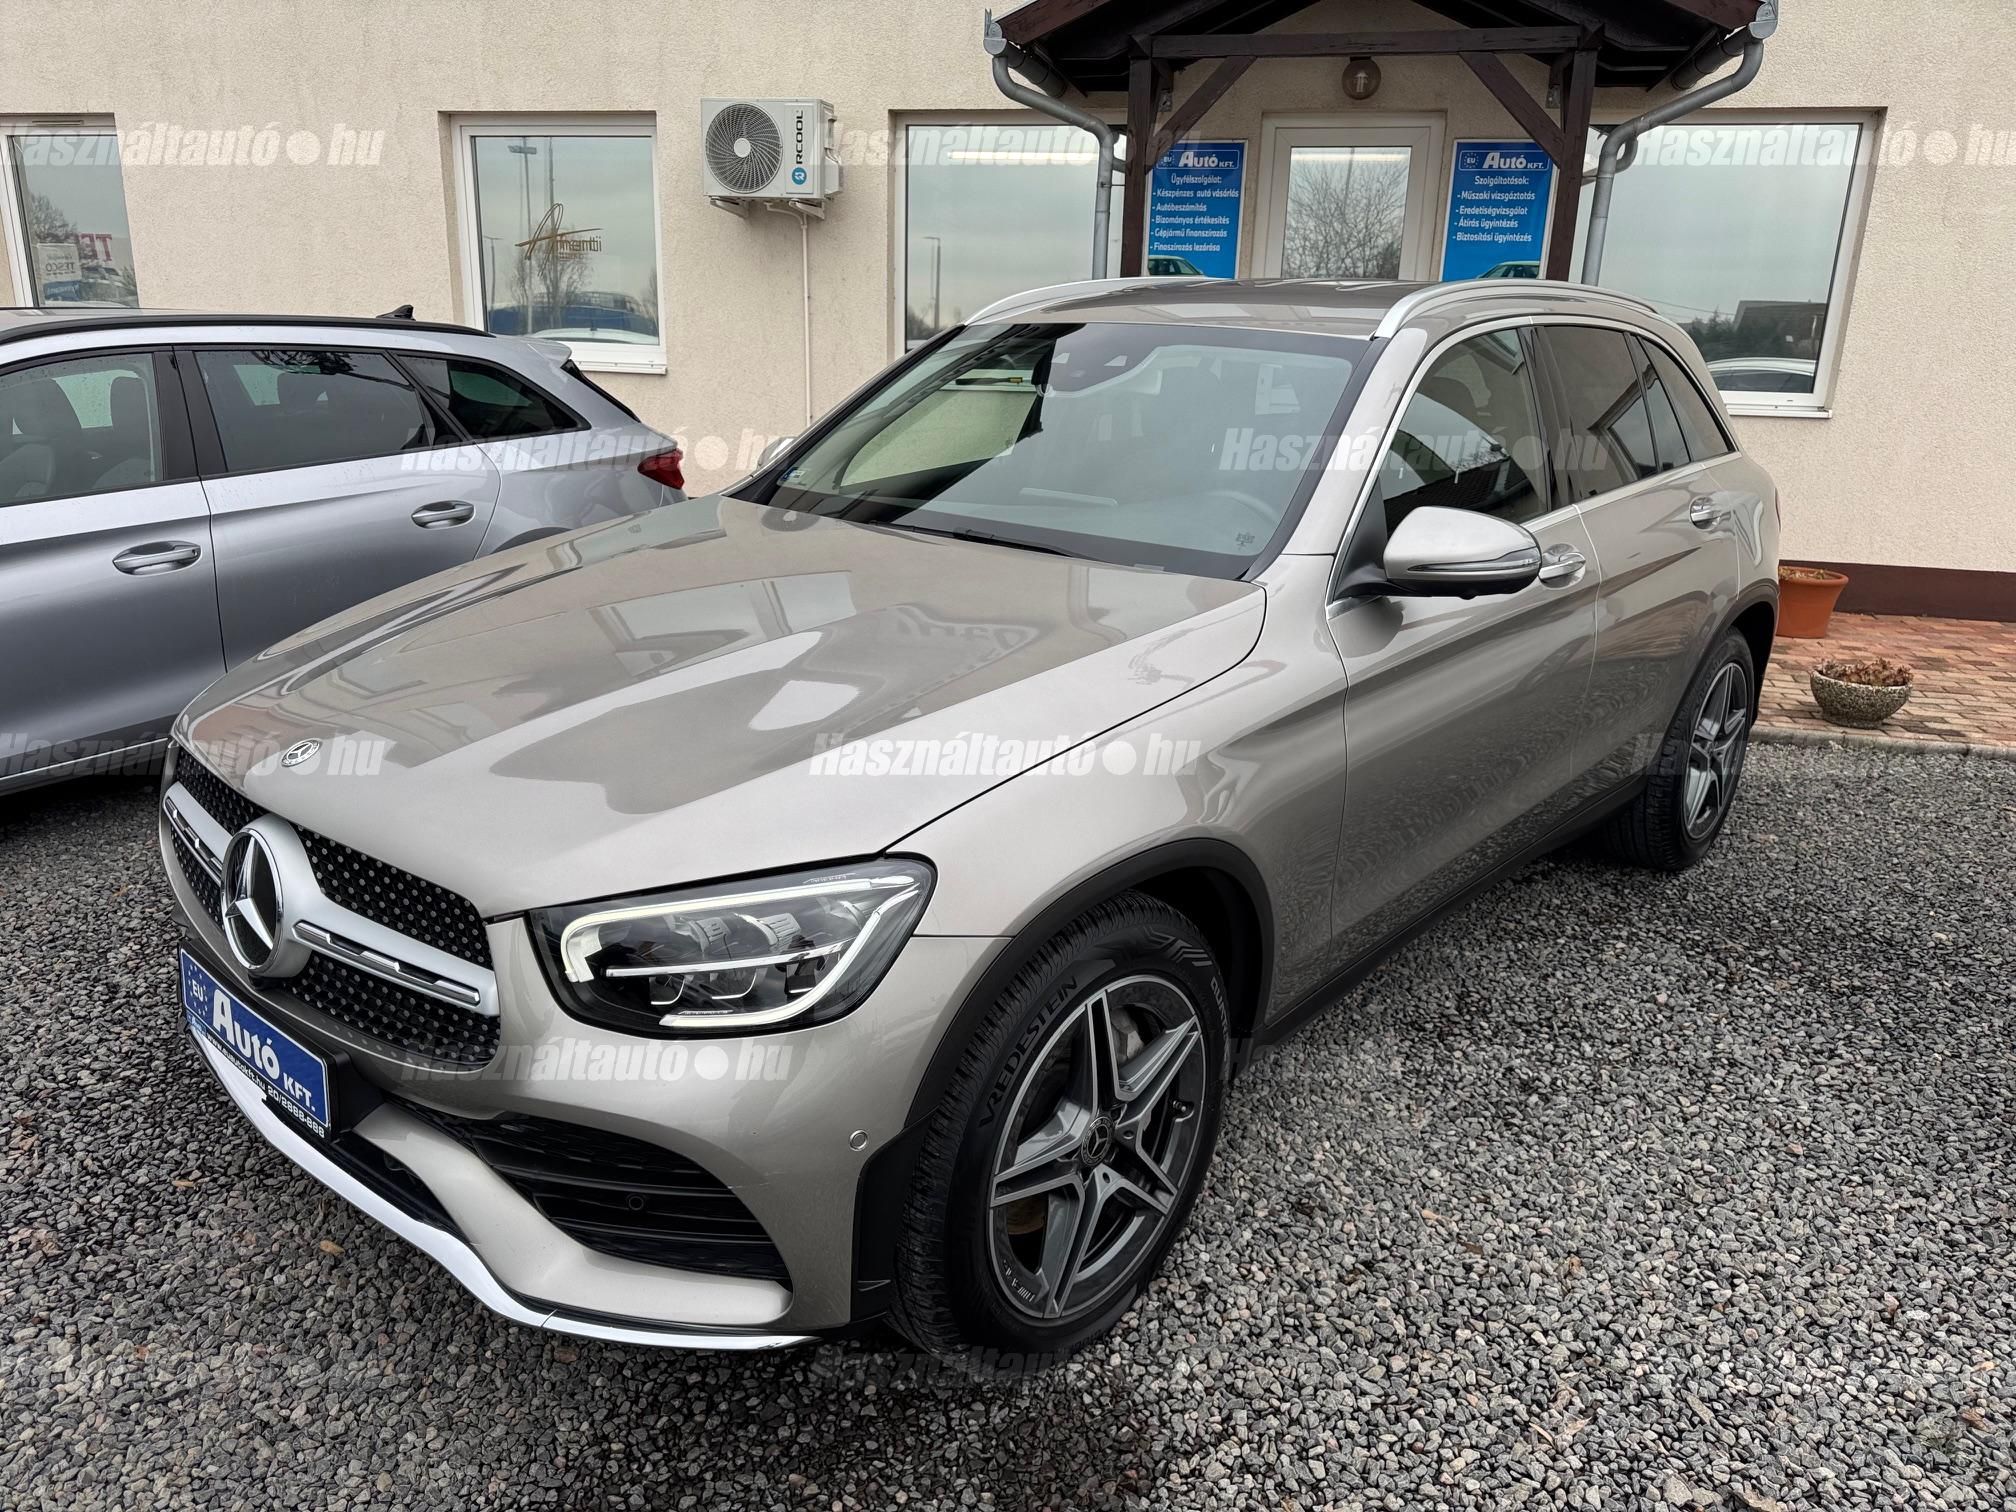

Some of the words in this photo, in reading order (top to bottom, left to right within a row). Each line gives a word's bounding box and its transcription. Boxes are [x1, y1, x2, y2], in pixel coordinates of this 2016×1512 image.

[795, 110, 804, 165] RCOOL
[1178, 151, 1219, 168] Autó
[1482, 152, 1527, 169] Autó
[1170, 173, 1223, 186] Ügyfélszolgálat:
[1474, 175, 1530, 187] Szolgáltatások:
[1157, 187, 1194, 199] Készpénzes
[1196, 188, 1212, 198] autó
[1213, 188, 1239, 198] vásárlás
[1461, 190, 1490, 200] Műszaki
[1491, 190, 1536, 202] vizsgáztatás
[1459, 205, 1529, 217] Eredetiségvizsgálat
[1155, 215, 1193, 226] Bizományos
[1194, 215, 1230, 225] értékesítés
[1481, 218, 1519, 230] ügyintézés
[1456, 231, 1493, 241] Biztosítási
[1494, 233, 1533, 244] ügyintézés
[191, 979, 205, 1003] EU
[212, 988, 281, 1080] Autó
[282, 1072, 316, 1112] KFT.
[978, 976, 1079, 1128] VREDESTEIN
[267, 1084, 326, 1139] 20/2888-888
